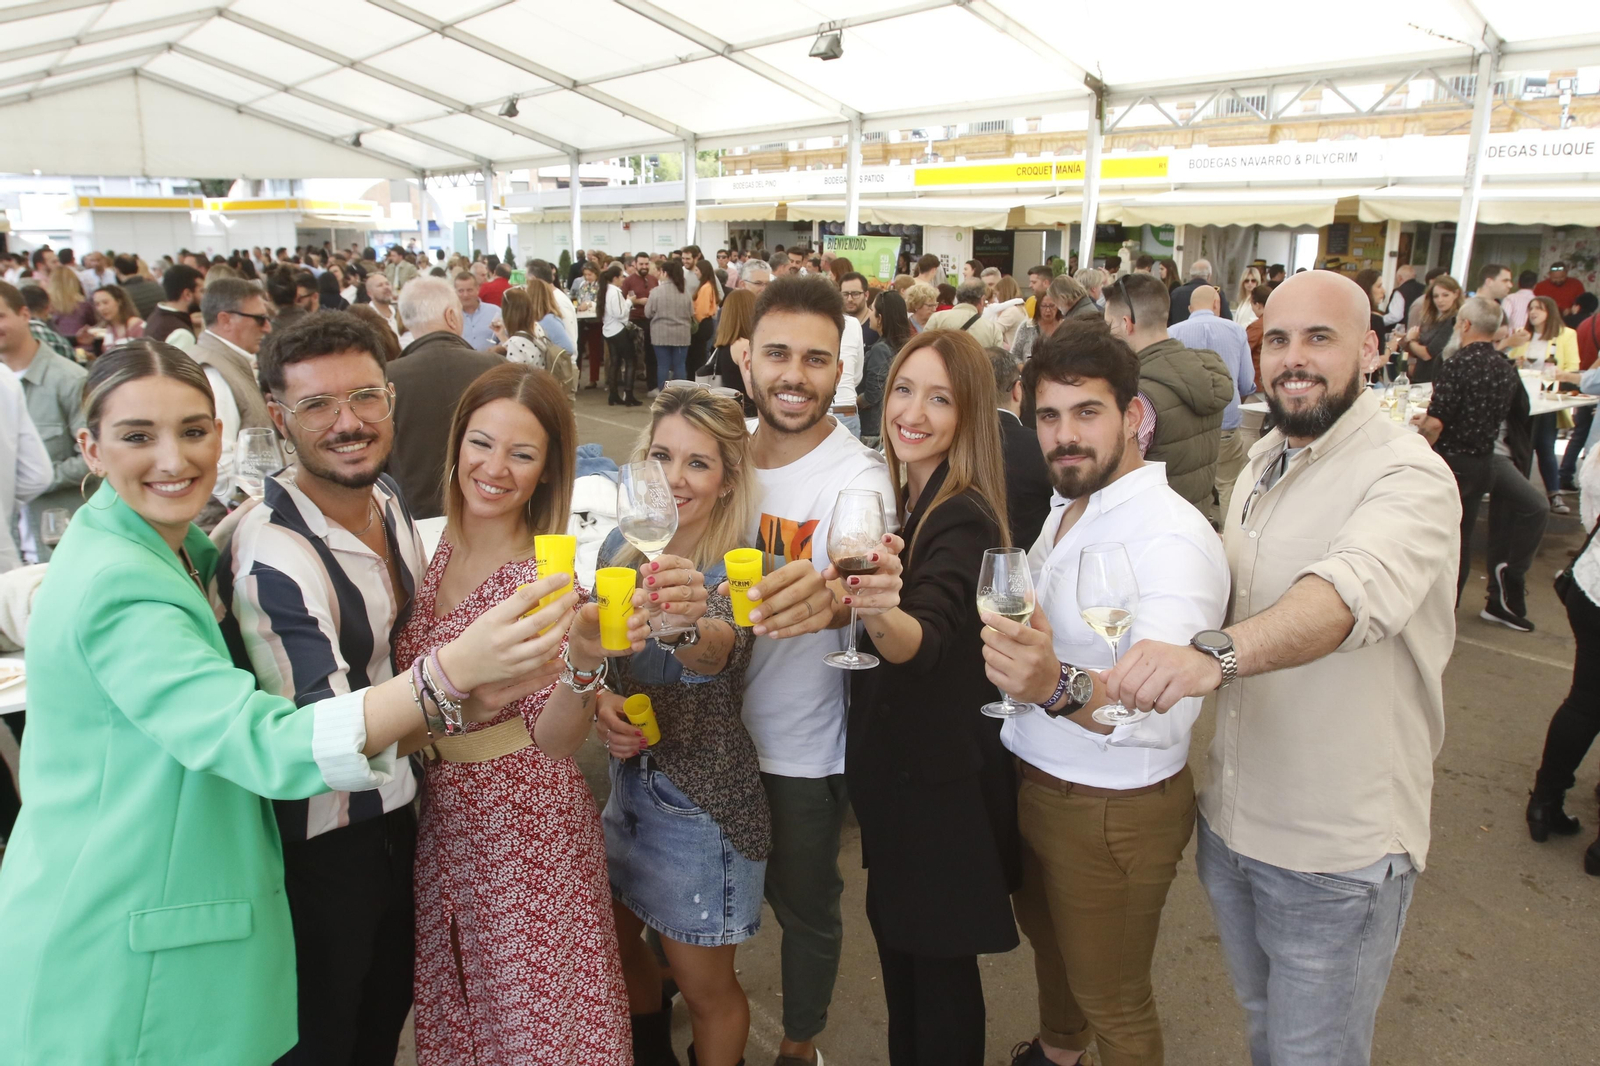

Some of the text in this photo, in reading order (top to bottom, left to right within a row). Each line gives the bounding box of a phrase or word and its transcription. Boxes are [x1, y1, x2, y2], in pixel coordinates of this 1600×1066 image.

[1485, 141, 1595, 158] DEGAS LUQUE
[1188, 152, 1358, 169] BODEGAS NAVARRO & PILYCRIM
[732, 181, 754, 190] BODEGAS
[824, 175, 847, 185] BODEGA
[864, 174, 884, 183] PATIOS
